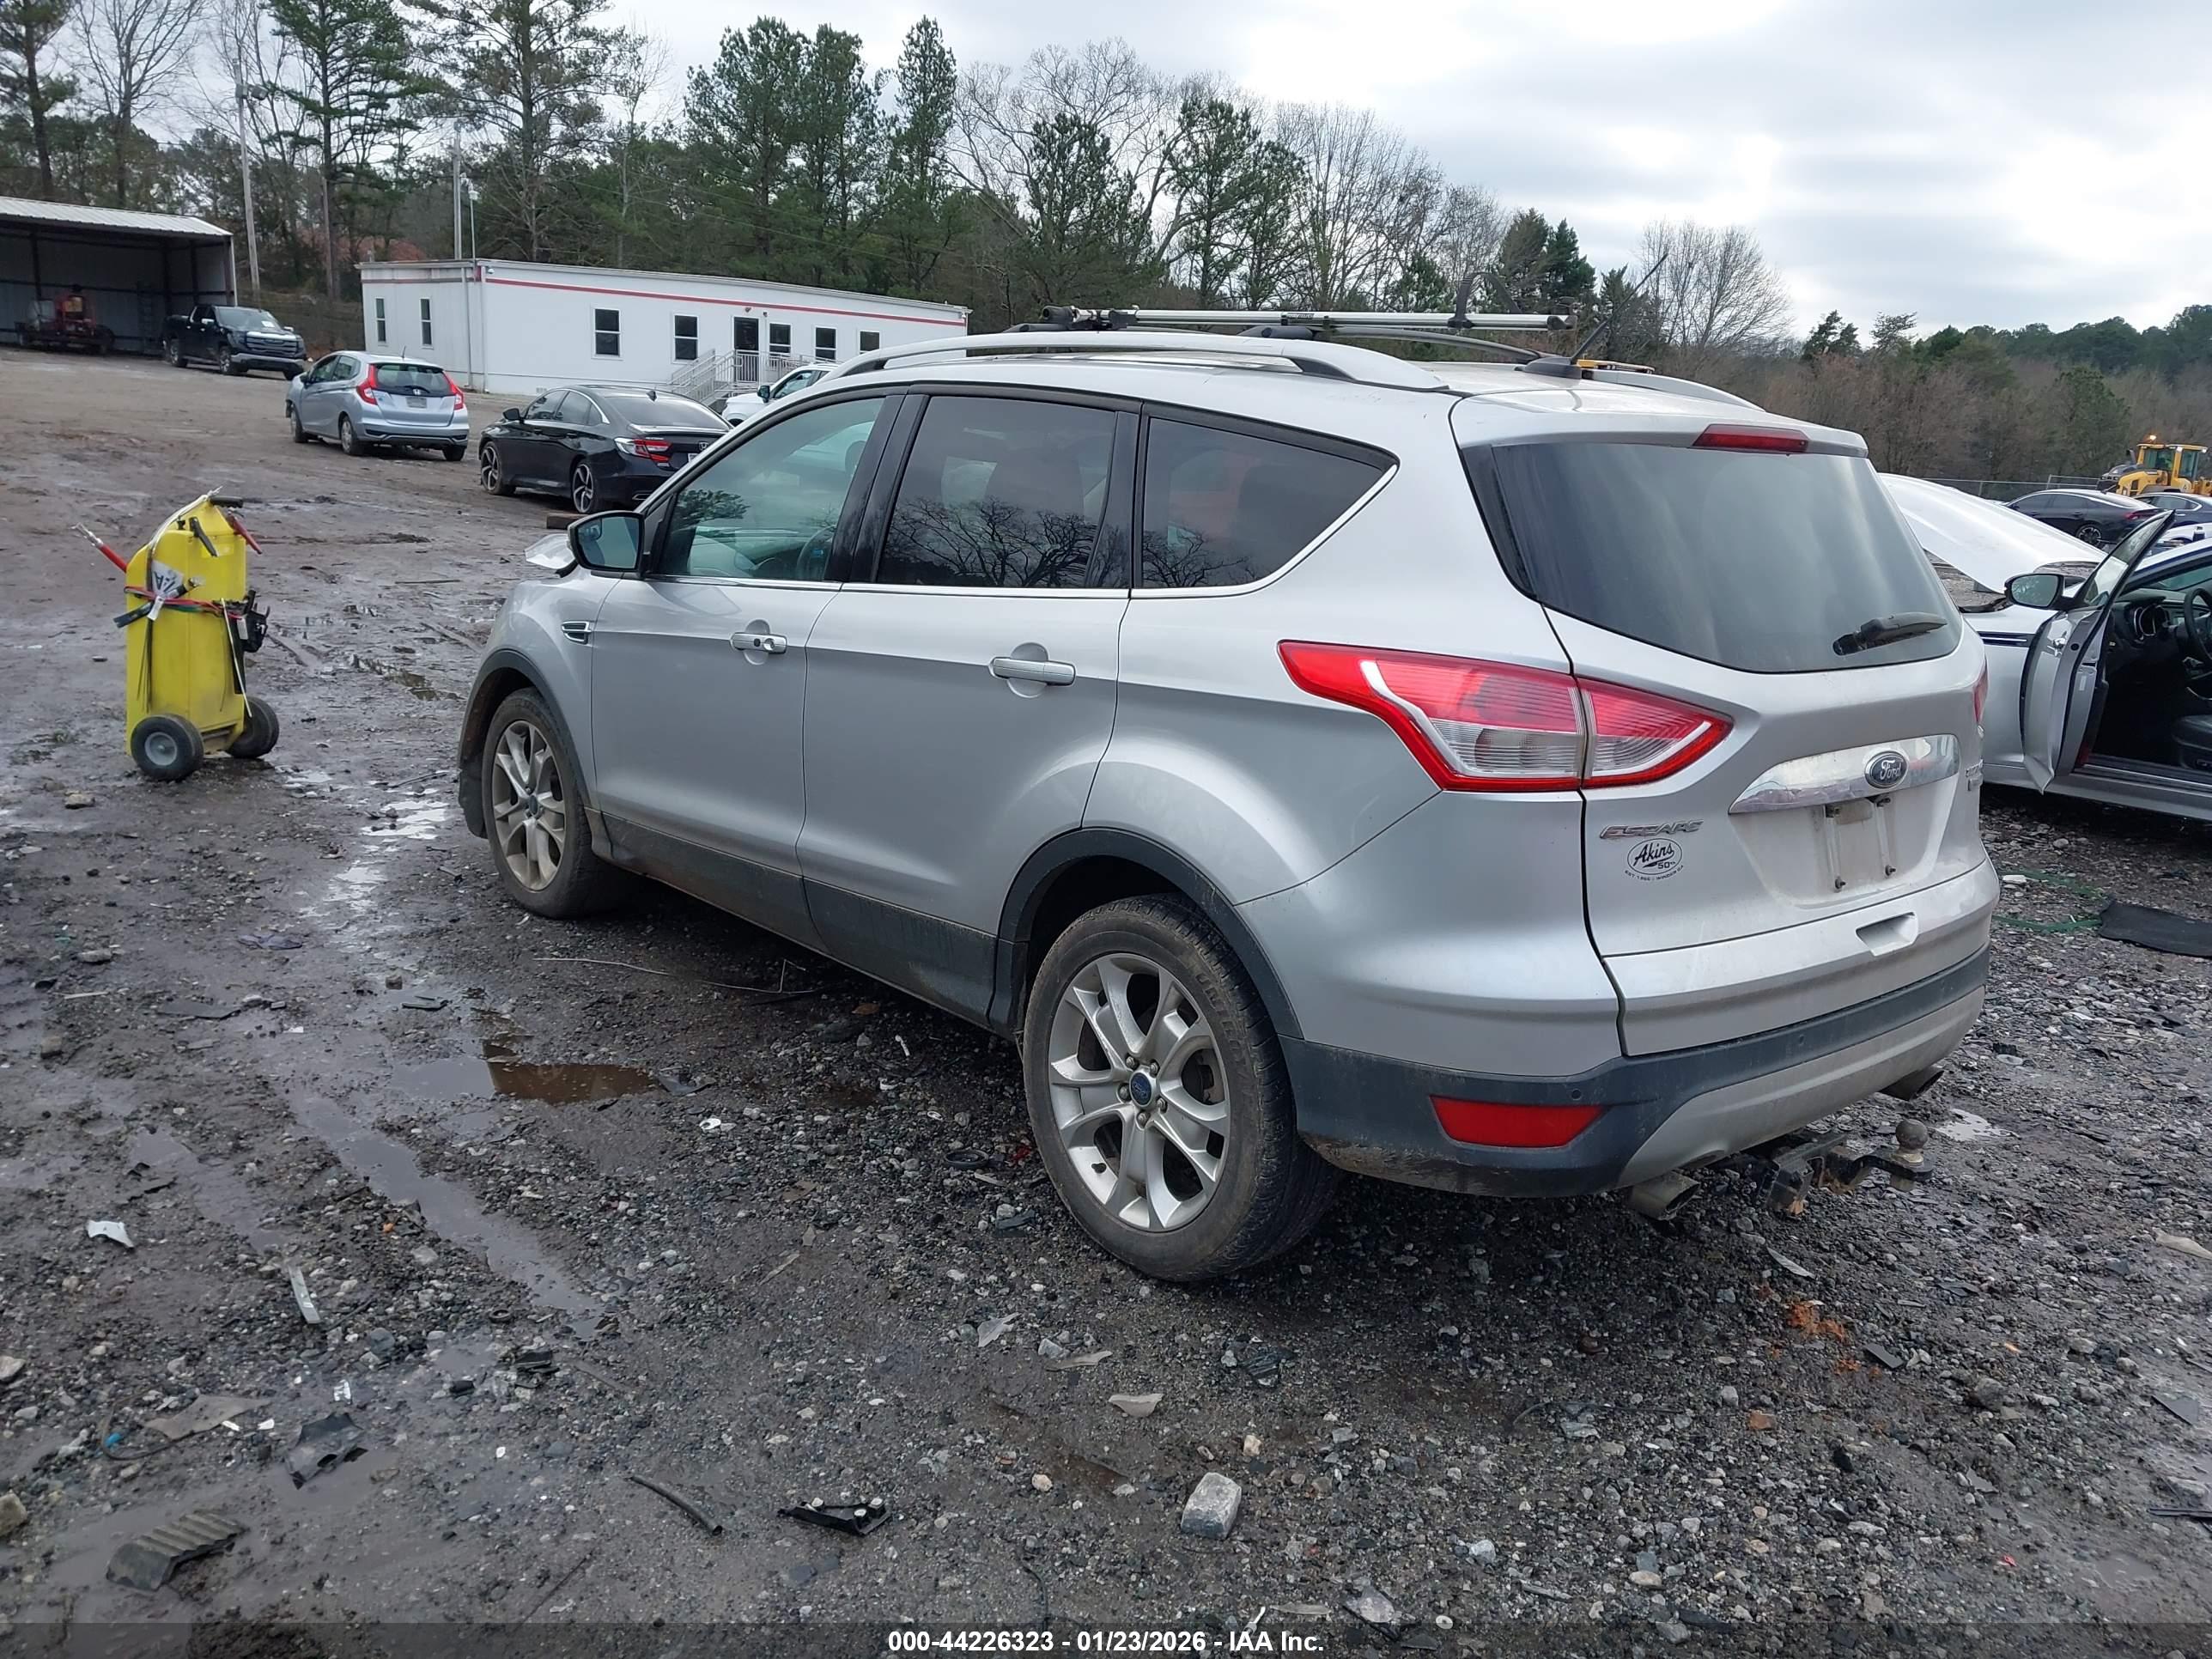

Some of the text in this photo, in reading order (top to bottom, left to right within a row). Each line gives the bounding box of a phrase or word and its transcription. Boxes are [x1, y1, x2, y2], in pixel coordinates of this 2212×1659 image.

[1880, 759, 1902, 780] Ford
[1600, 819, 1704, 839] ESCAPE
[1633, 842, 1674, 867] Akins
